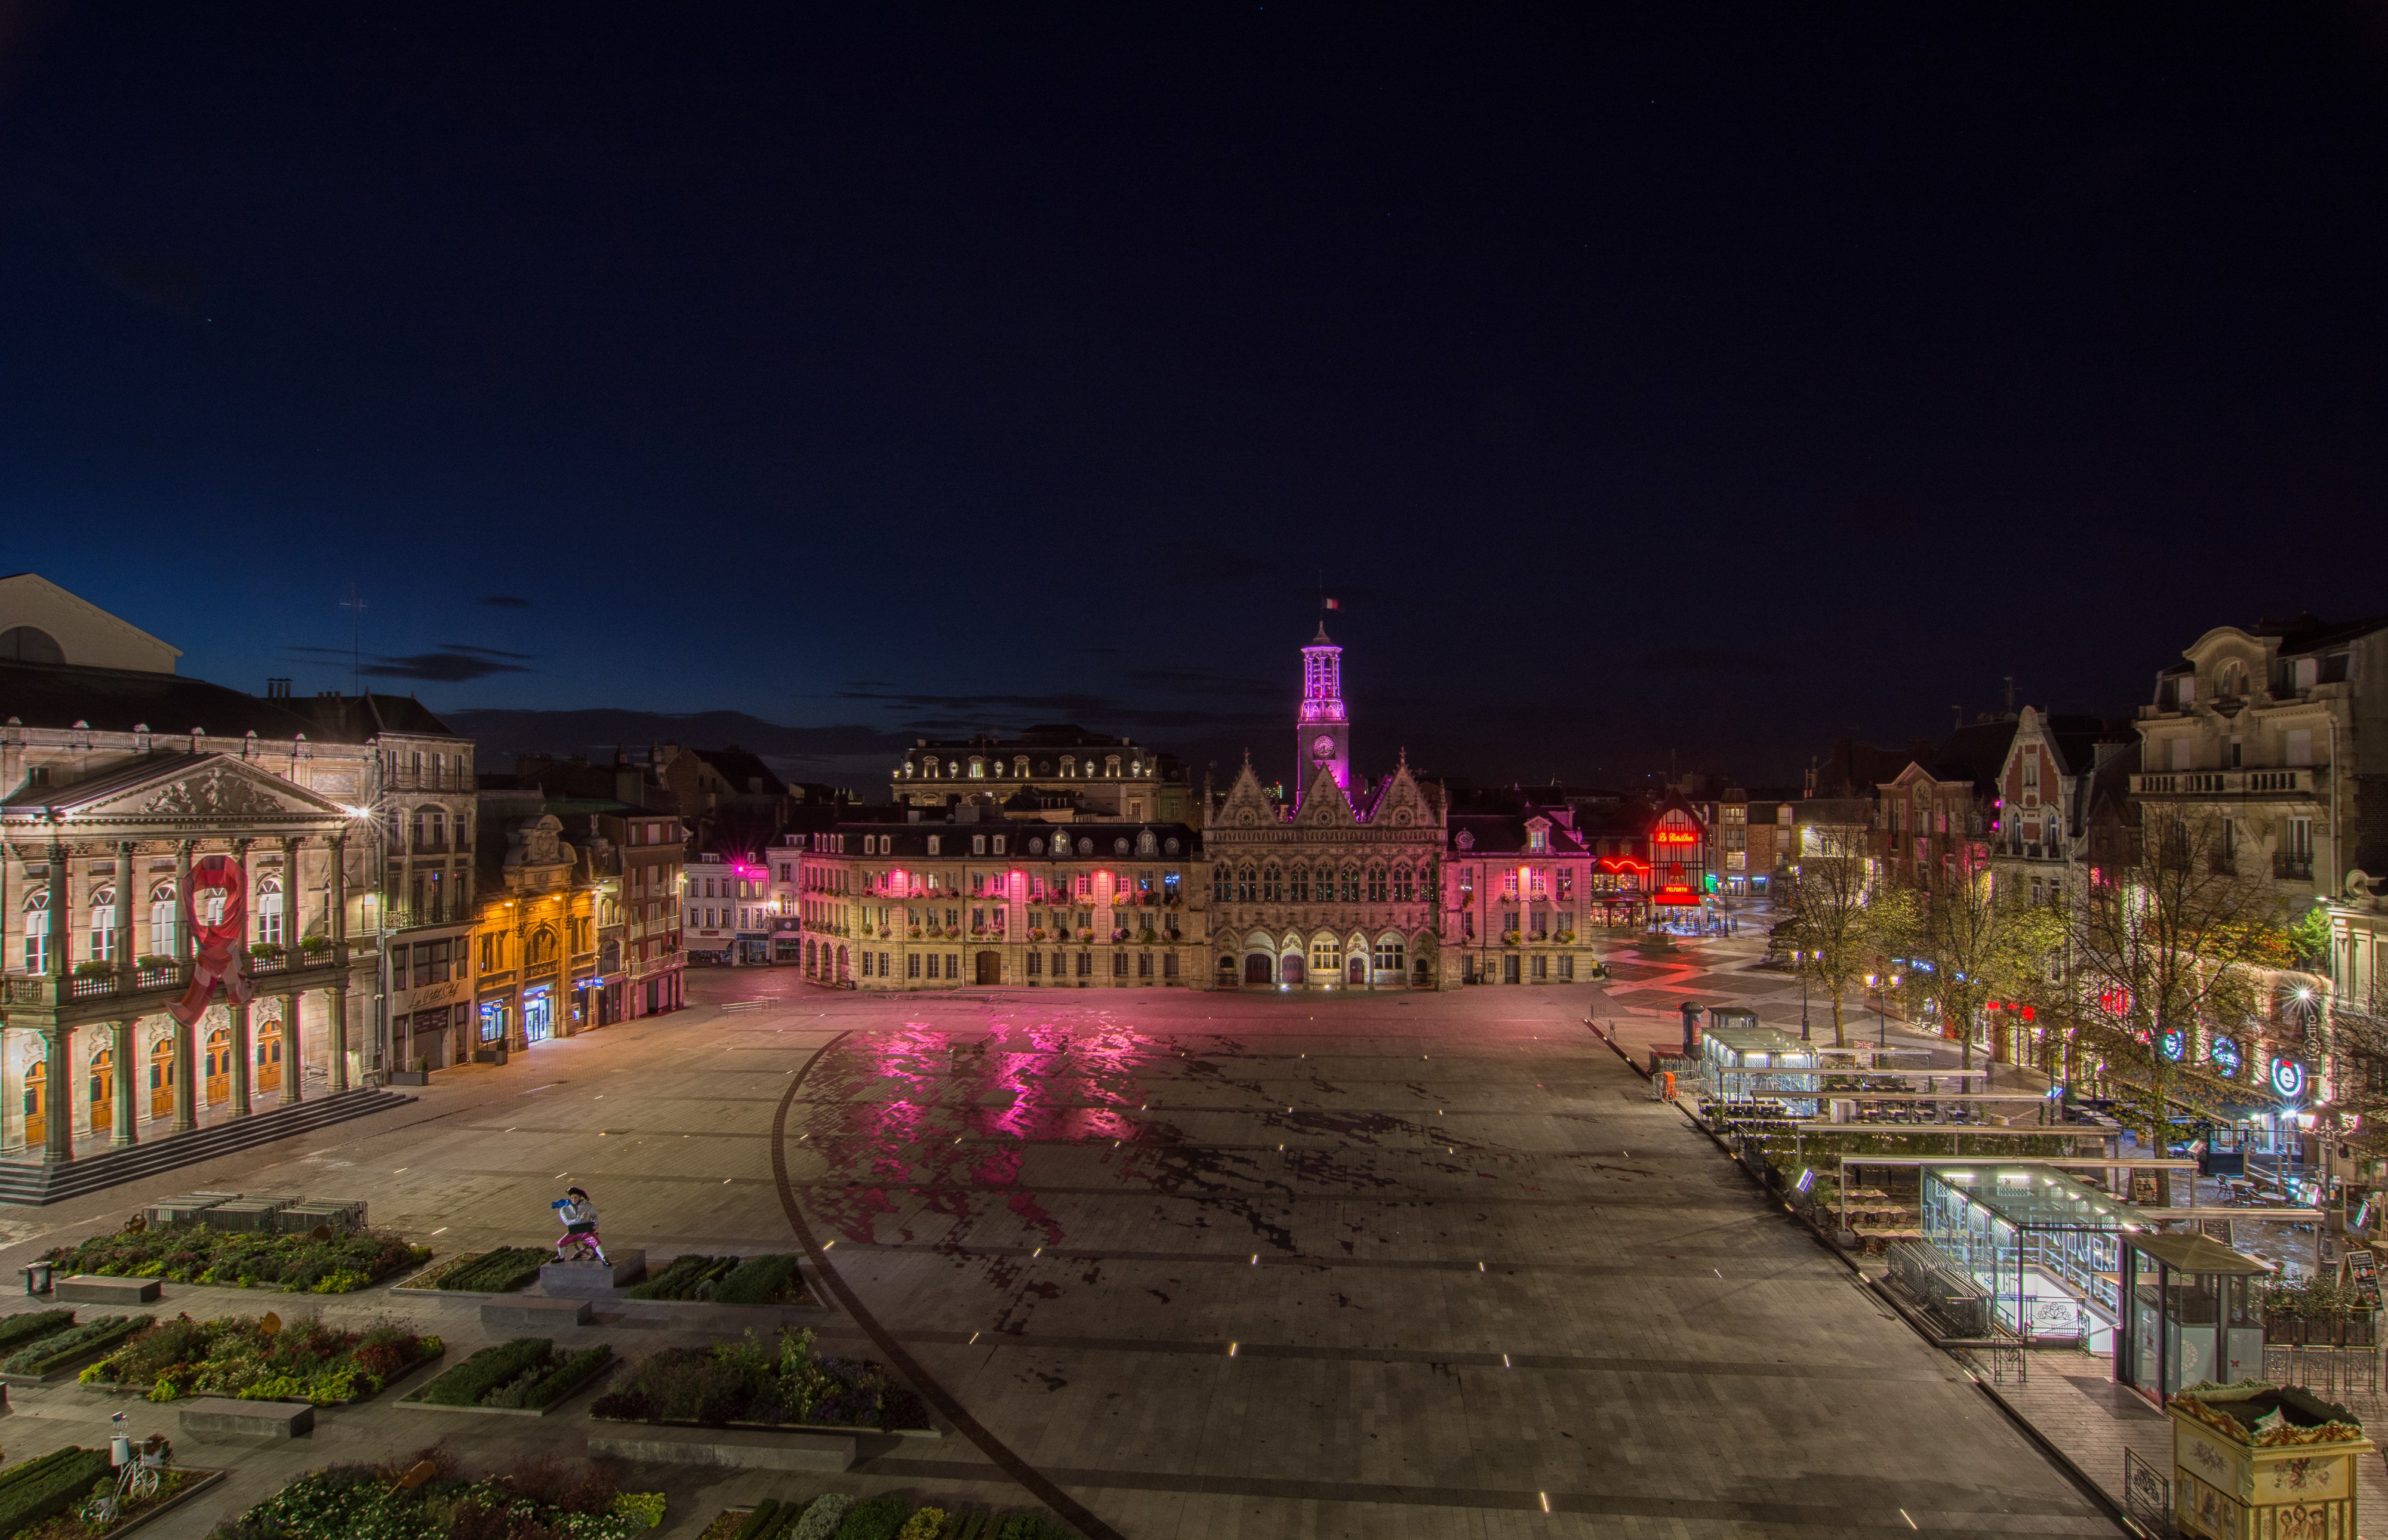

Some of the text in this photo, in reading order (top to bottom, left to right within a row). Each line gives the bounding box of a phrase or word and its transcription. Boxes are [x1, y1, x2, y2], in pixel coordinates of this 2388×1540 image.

[1658, 833, 1694, 842] Le Carillon
[408, 982, 460, 1009] Le Petit Chef
